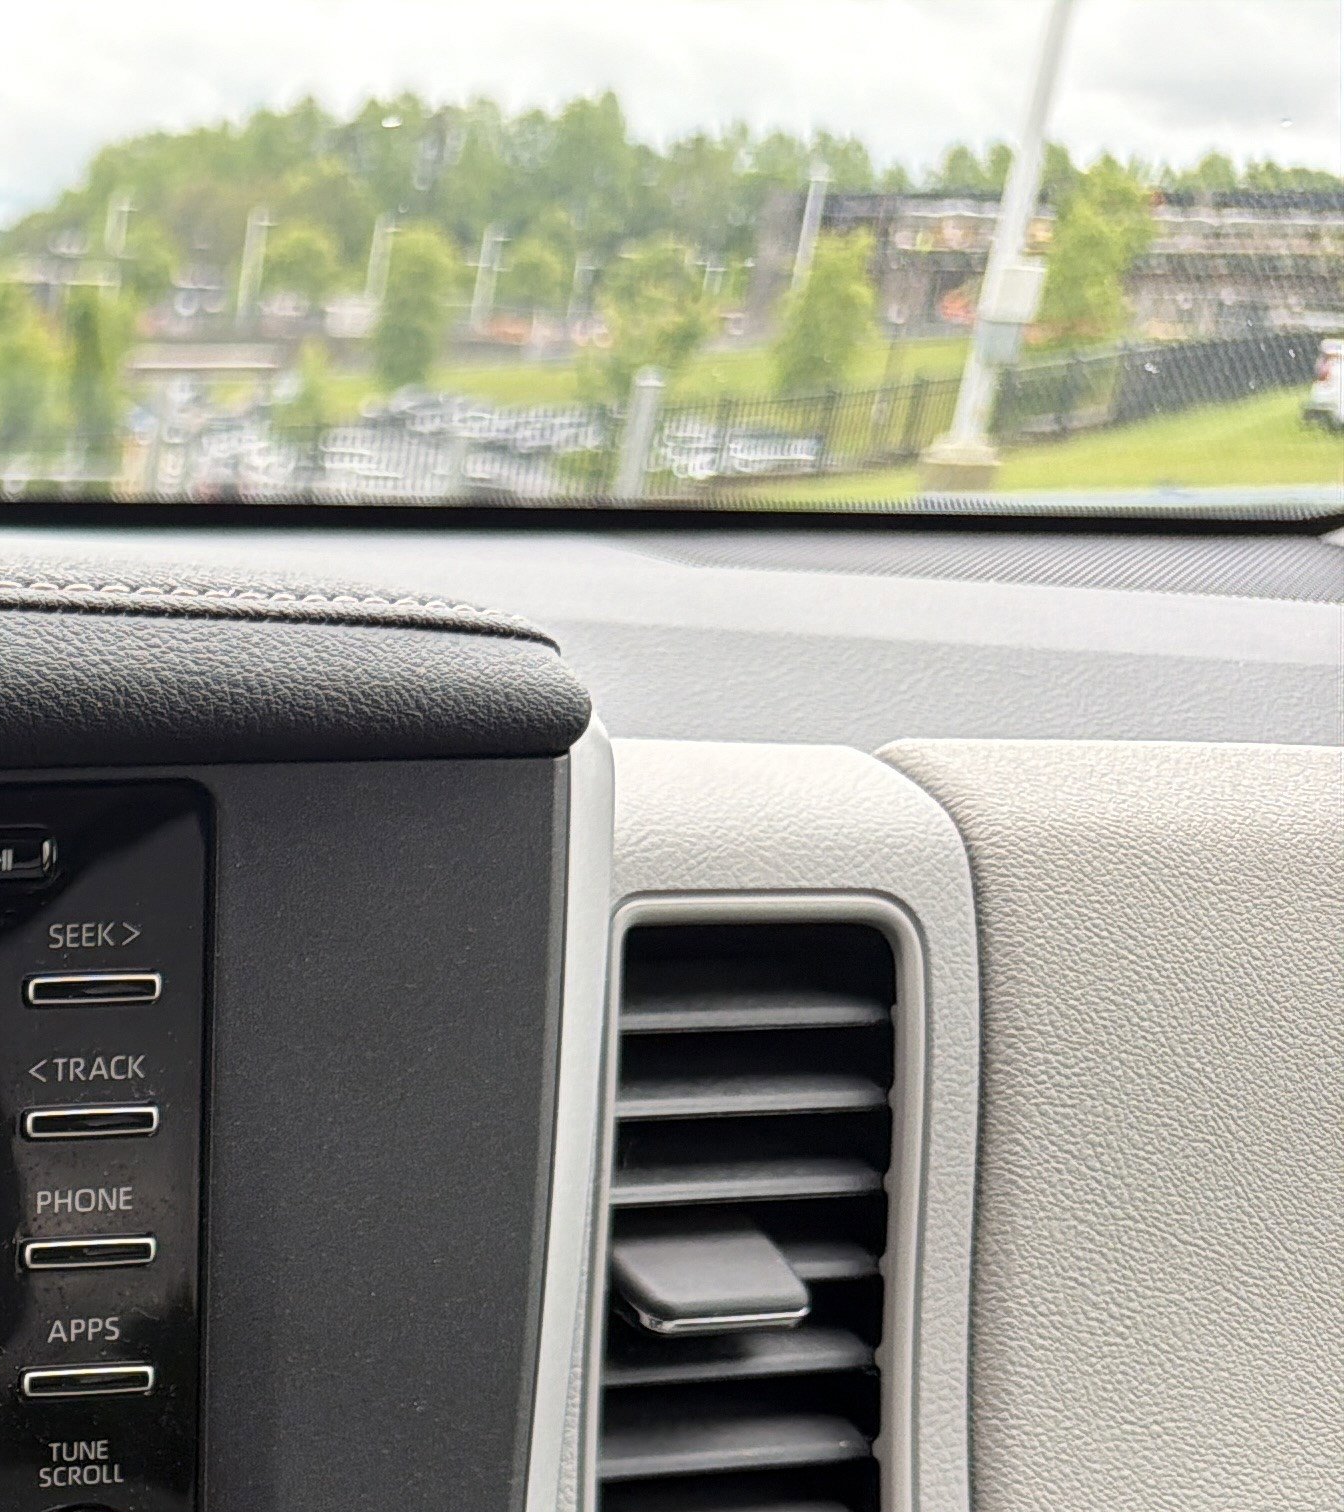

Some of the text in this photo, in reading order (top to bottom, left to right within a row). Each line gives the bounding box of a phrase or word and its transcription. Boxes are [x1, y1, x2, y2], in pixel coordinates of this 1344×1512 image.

[47, 922, 116, 948] SEEK
[53, 1053, 146, 1083] TRACK
[35, 1185, 134, 1213] PHONE
[46, 1316, 120, 1343] APPS
[47, 1440, 109, 1463] TUNE
[38, 1463, 125, 1487] SCROLL
